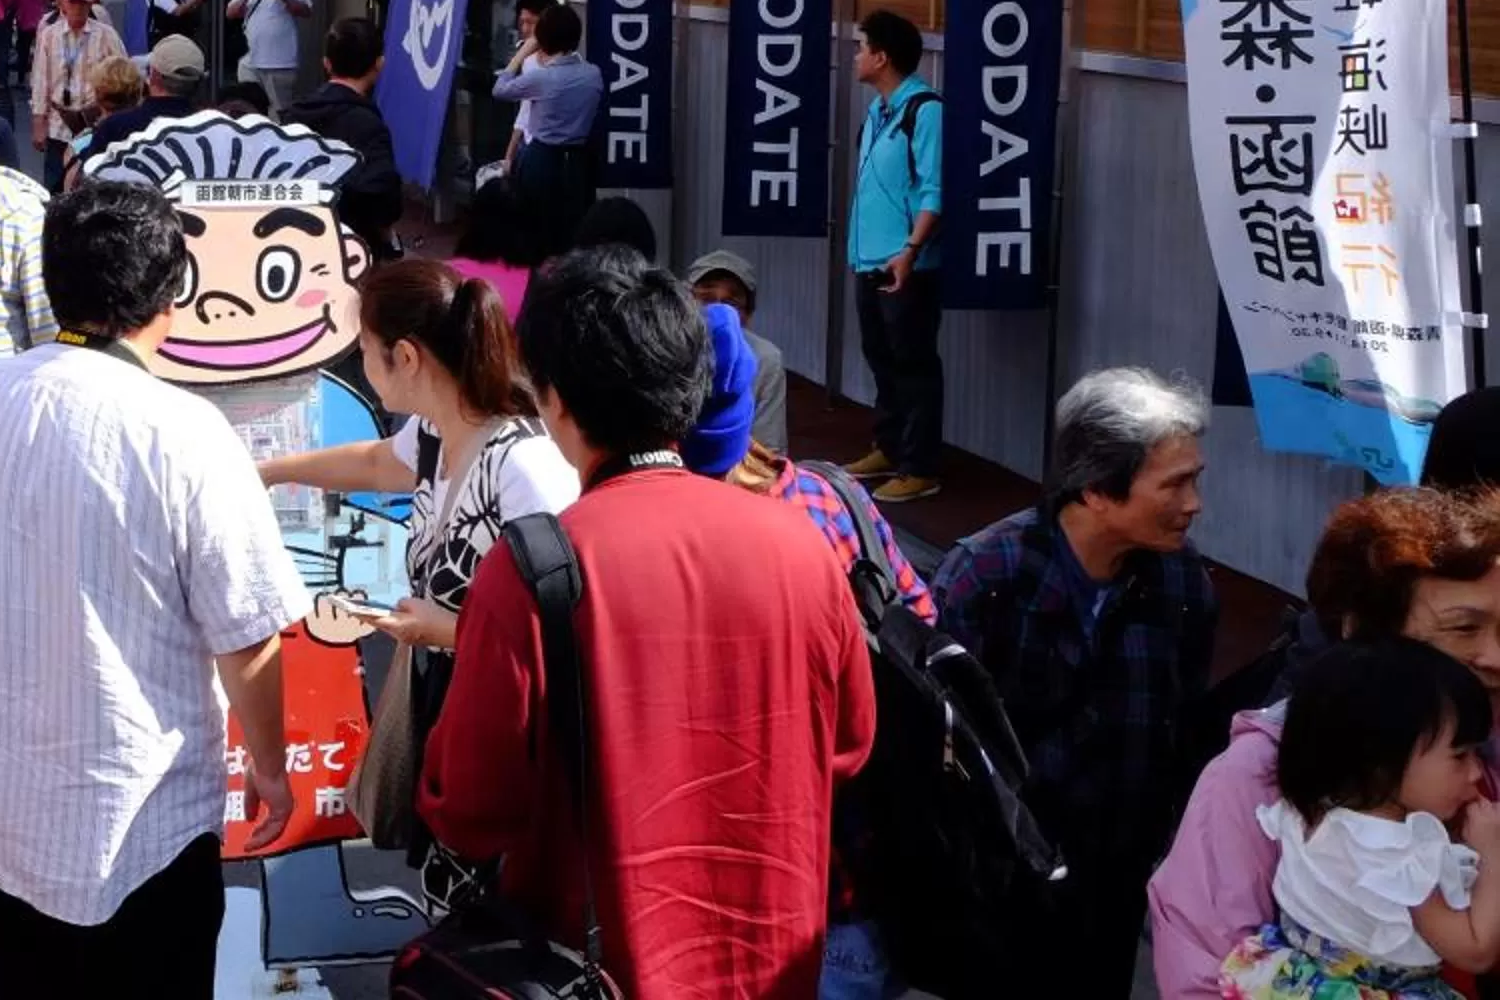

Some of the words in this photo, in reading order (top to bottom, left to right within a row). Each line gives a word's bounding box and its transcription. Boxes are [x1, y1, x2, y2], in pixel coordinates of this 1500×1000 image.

[196, 183, 303, 202] 函館朝市連合会
[224, 740, 346, 774] はだて
